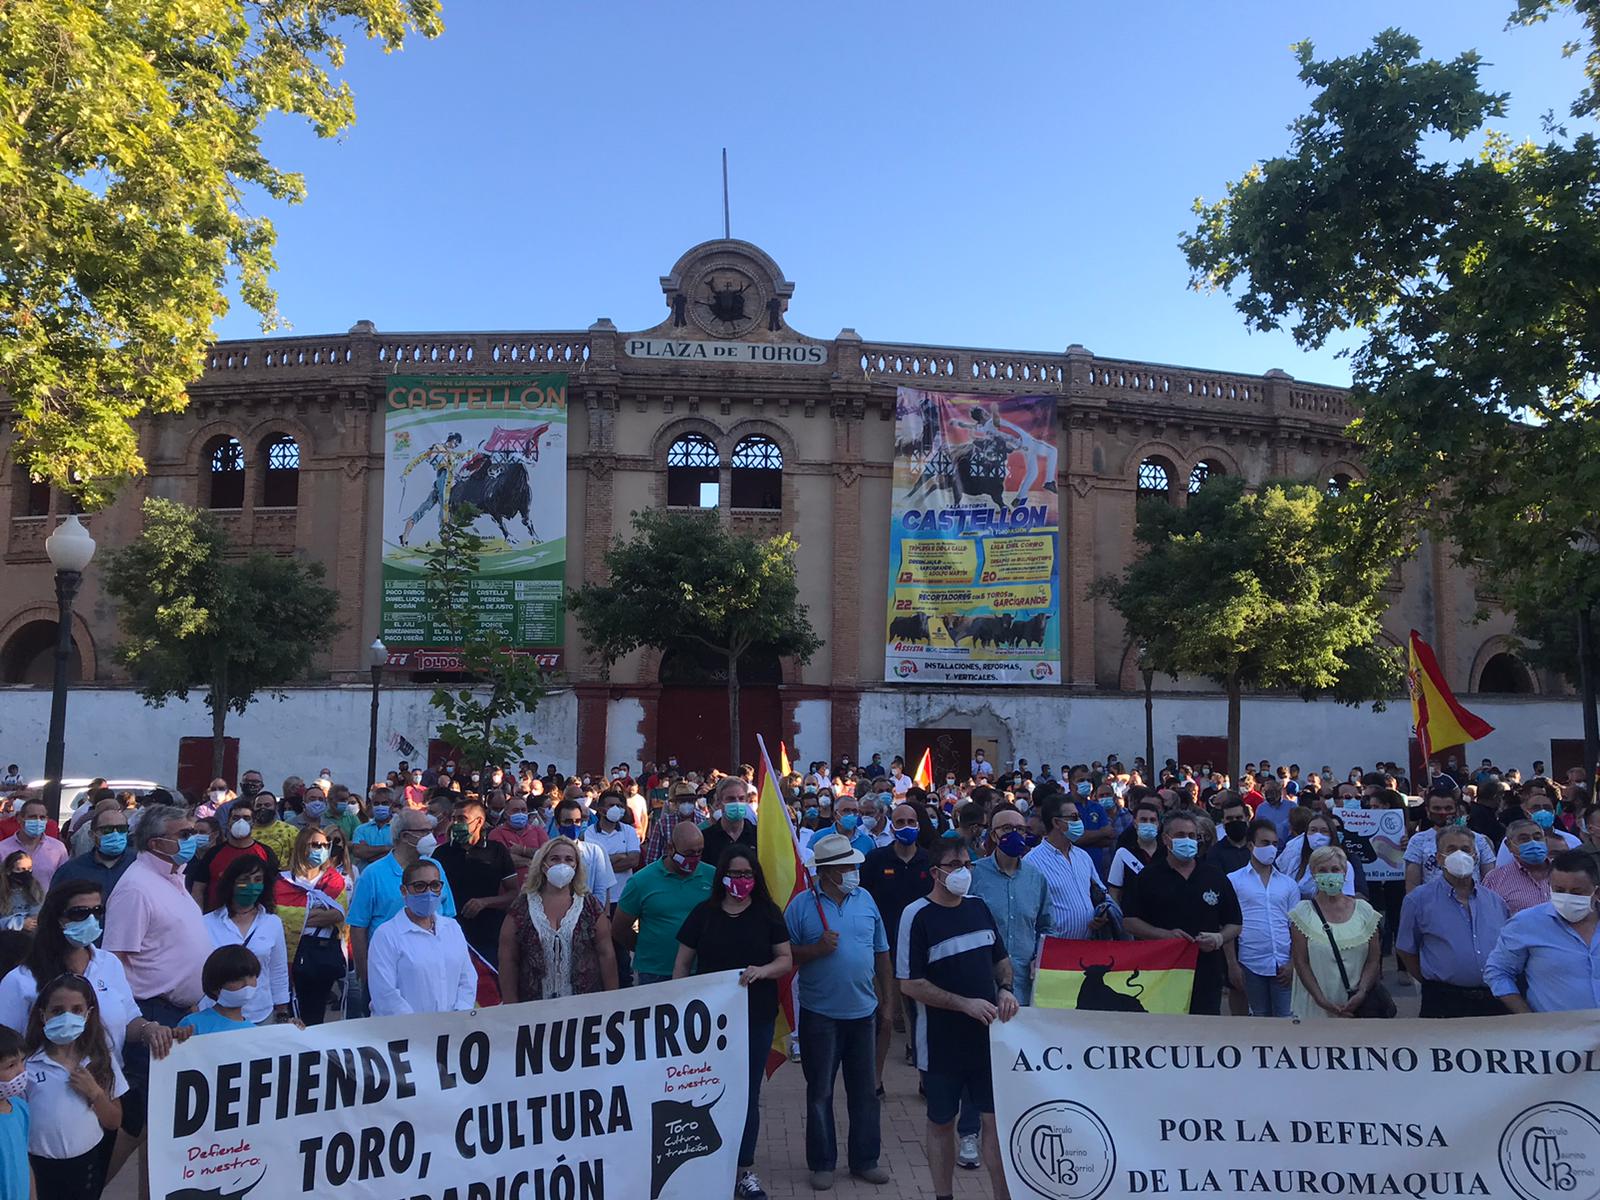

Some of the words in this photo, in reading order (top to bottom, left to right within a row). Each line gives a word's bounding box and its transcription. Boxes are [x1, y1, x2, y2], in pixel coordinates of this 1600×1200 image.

[630, 340, 708, 358] PLAZA
[713, 346, 738, 357] DE
[748, 345, 822, 362] TOROS
[388, 382, 566, 410] CASTELLÓN
[902, 498, 1048, 533] CASTELLÓN
[982, 571, 997, 582] 20
[895, 600, 912, 610] 22
[924, 662, 981, 671] INSTALACIONES,
[982, 663, 1022, 671] REFORMAS,
[953, 673, 998, 681] VERTICALES.
[436, 1030, 490, 1090] LO
[515, 999, 728, 1077] NUESTRO:
[1011, 1047, 1073, 1072] A.C.
[1083, 1045, 1242, 1070] CIRCULO
[1252, 1045, 1418, 1073] TAURINO
[1429, 1048, 1600, 1074] BORRIOL
[666, 1061, 712, 1078] Defiende
[173, 1039, 416, 1138] DEFIENDE
[664, 1081, 674, 1093] lo
[665, 1119, 699, 1134] Toro
[1159, 1118, 1226, 1142] POR
[1235, 1119, 1281, 1143] LA
[1290, 1120, 1449, 1148] DEFENSA
[300, 1120, 431, 1192] TORO,
[455, 1085, 633, 1159] CULTURA
[664, 1135, 701, 1147] Cultura
[187, 1139, 251, 1161] Defiende
[665, 1142, 708, 1157] tradición
[183, 1165, 195, 1180] lo
[1127, 1169, 1169, 1193] DE
[1178, 1168, 1222, 1193] LA
[1229, 1169, 1492, 1200] TAUROMAQUIA
